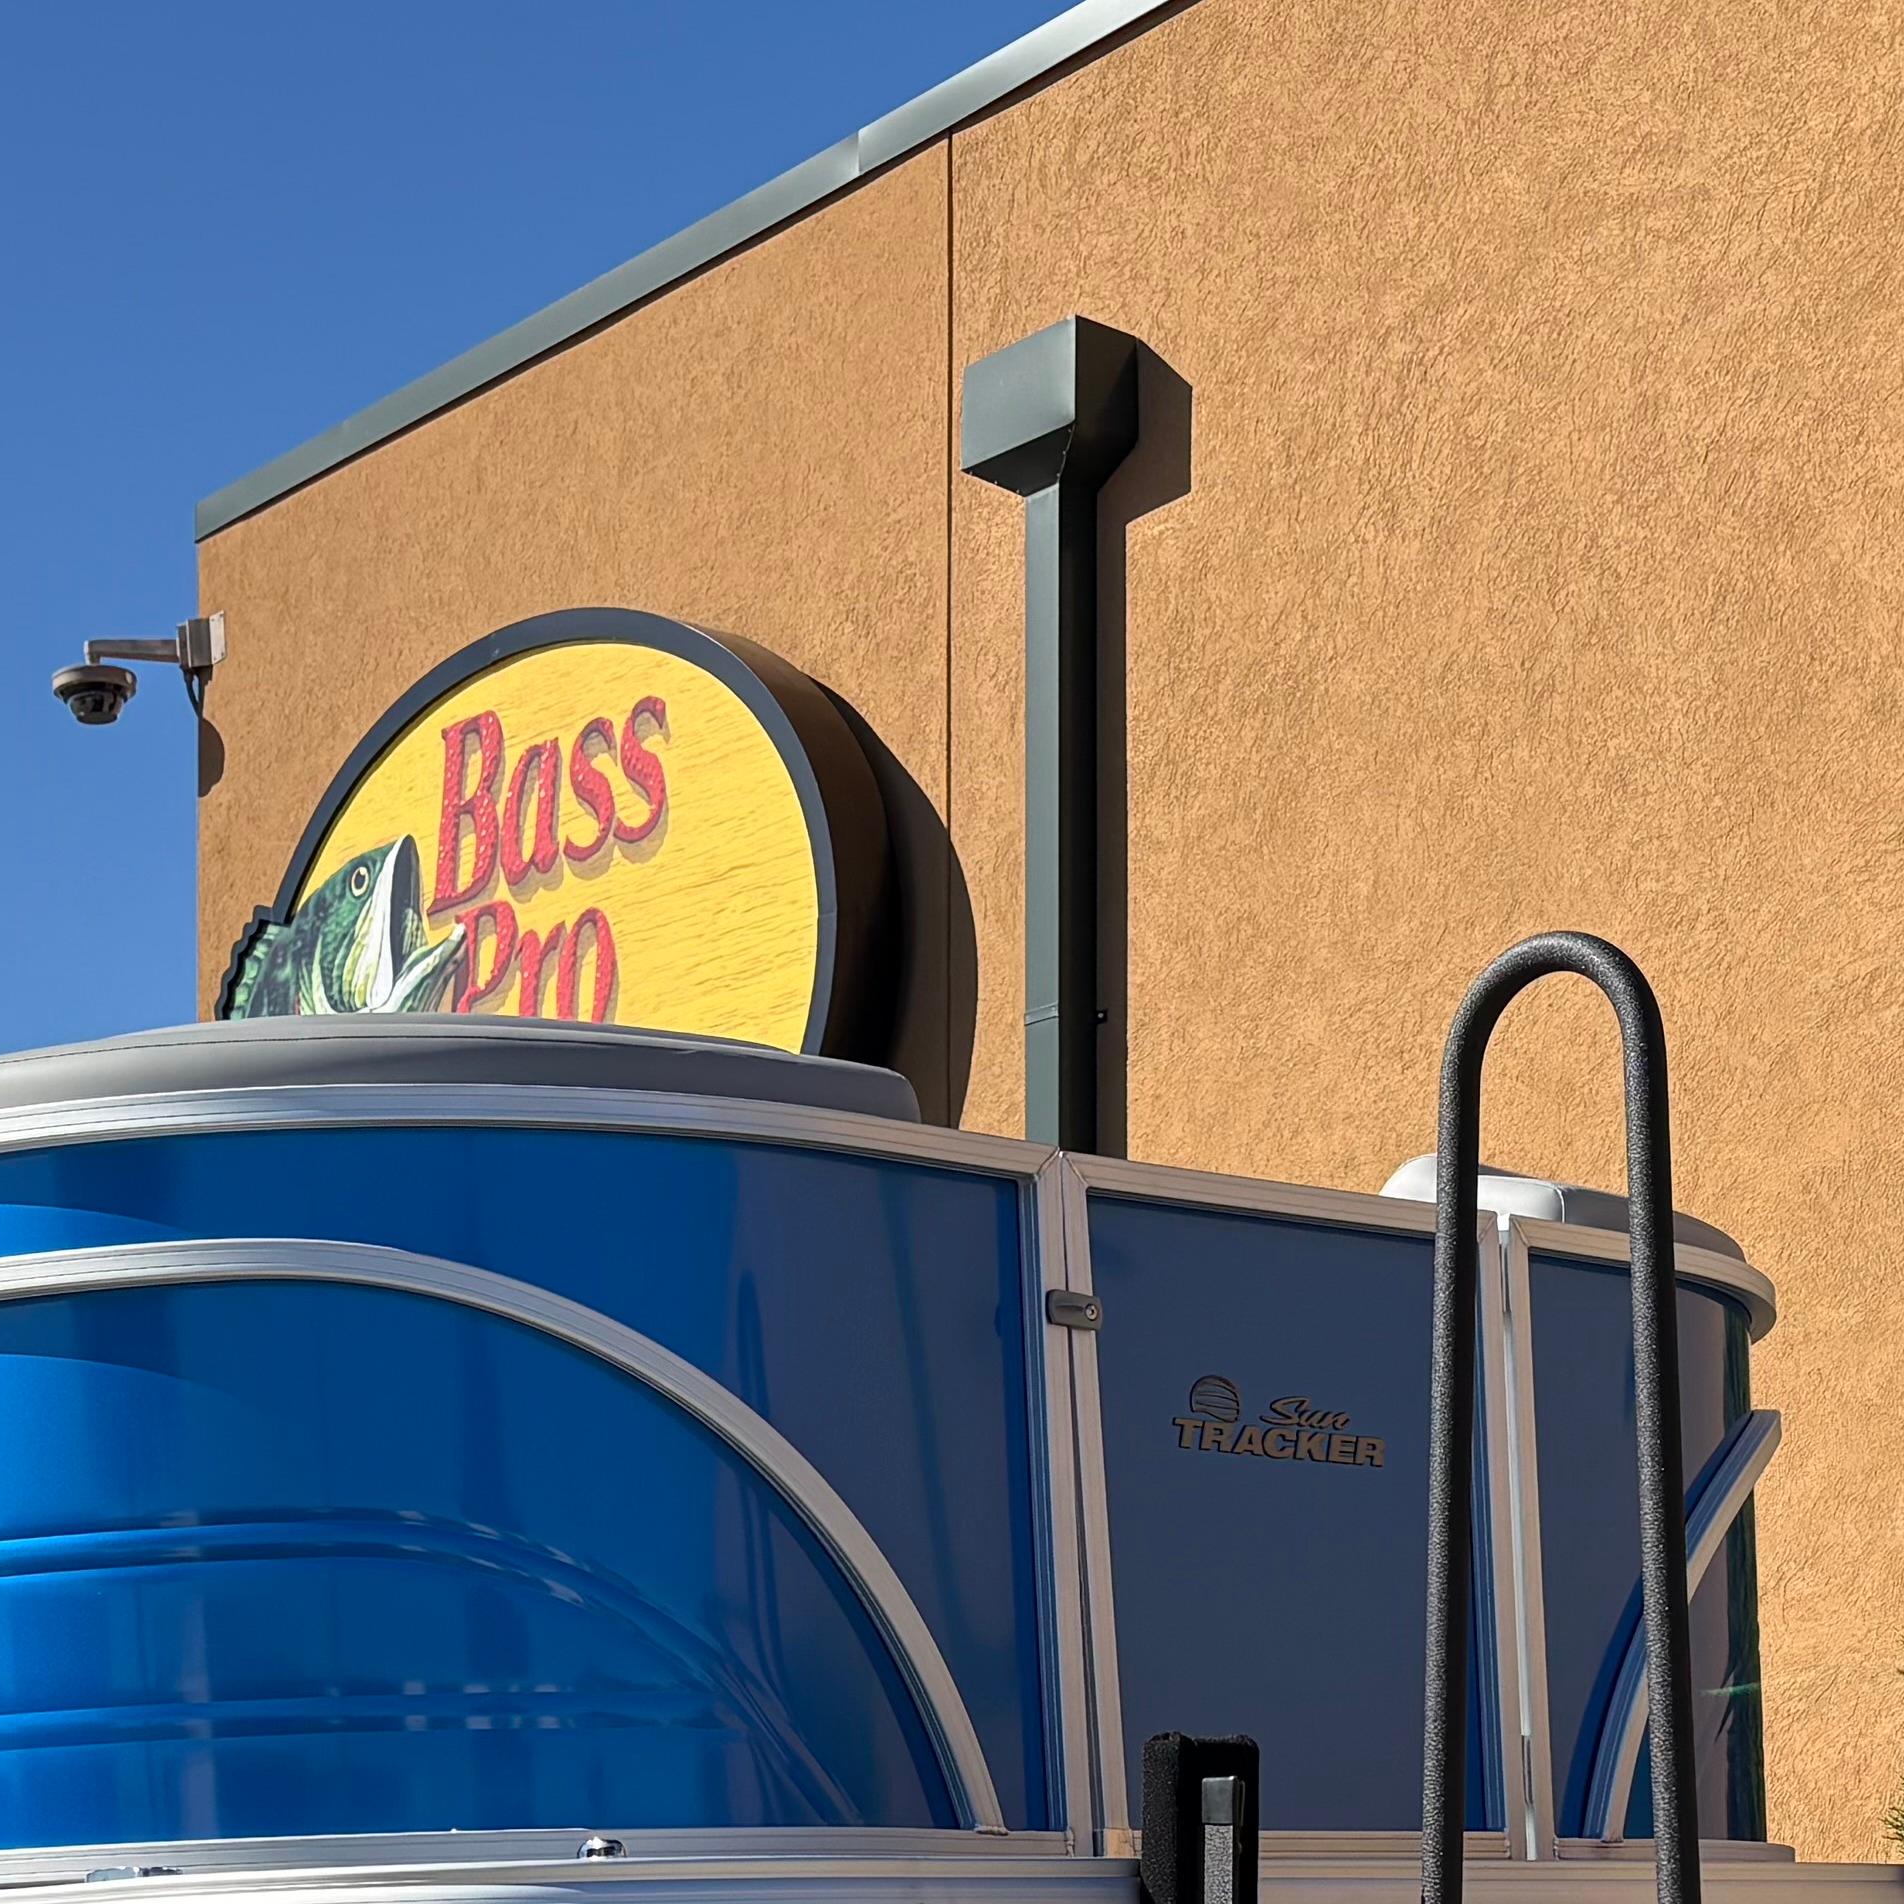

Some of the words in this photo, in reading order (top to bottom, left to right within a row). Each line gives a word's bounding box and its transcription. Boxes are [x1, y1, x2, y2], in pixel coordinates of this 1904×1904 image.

[427, 696, 667, 913] Bass
[1260, 1396, 1351, 1431] Sun
[1172, 1416, 1385, 1467] TRACKER
